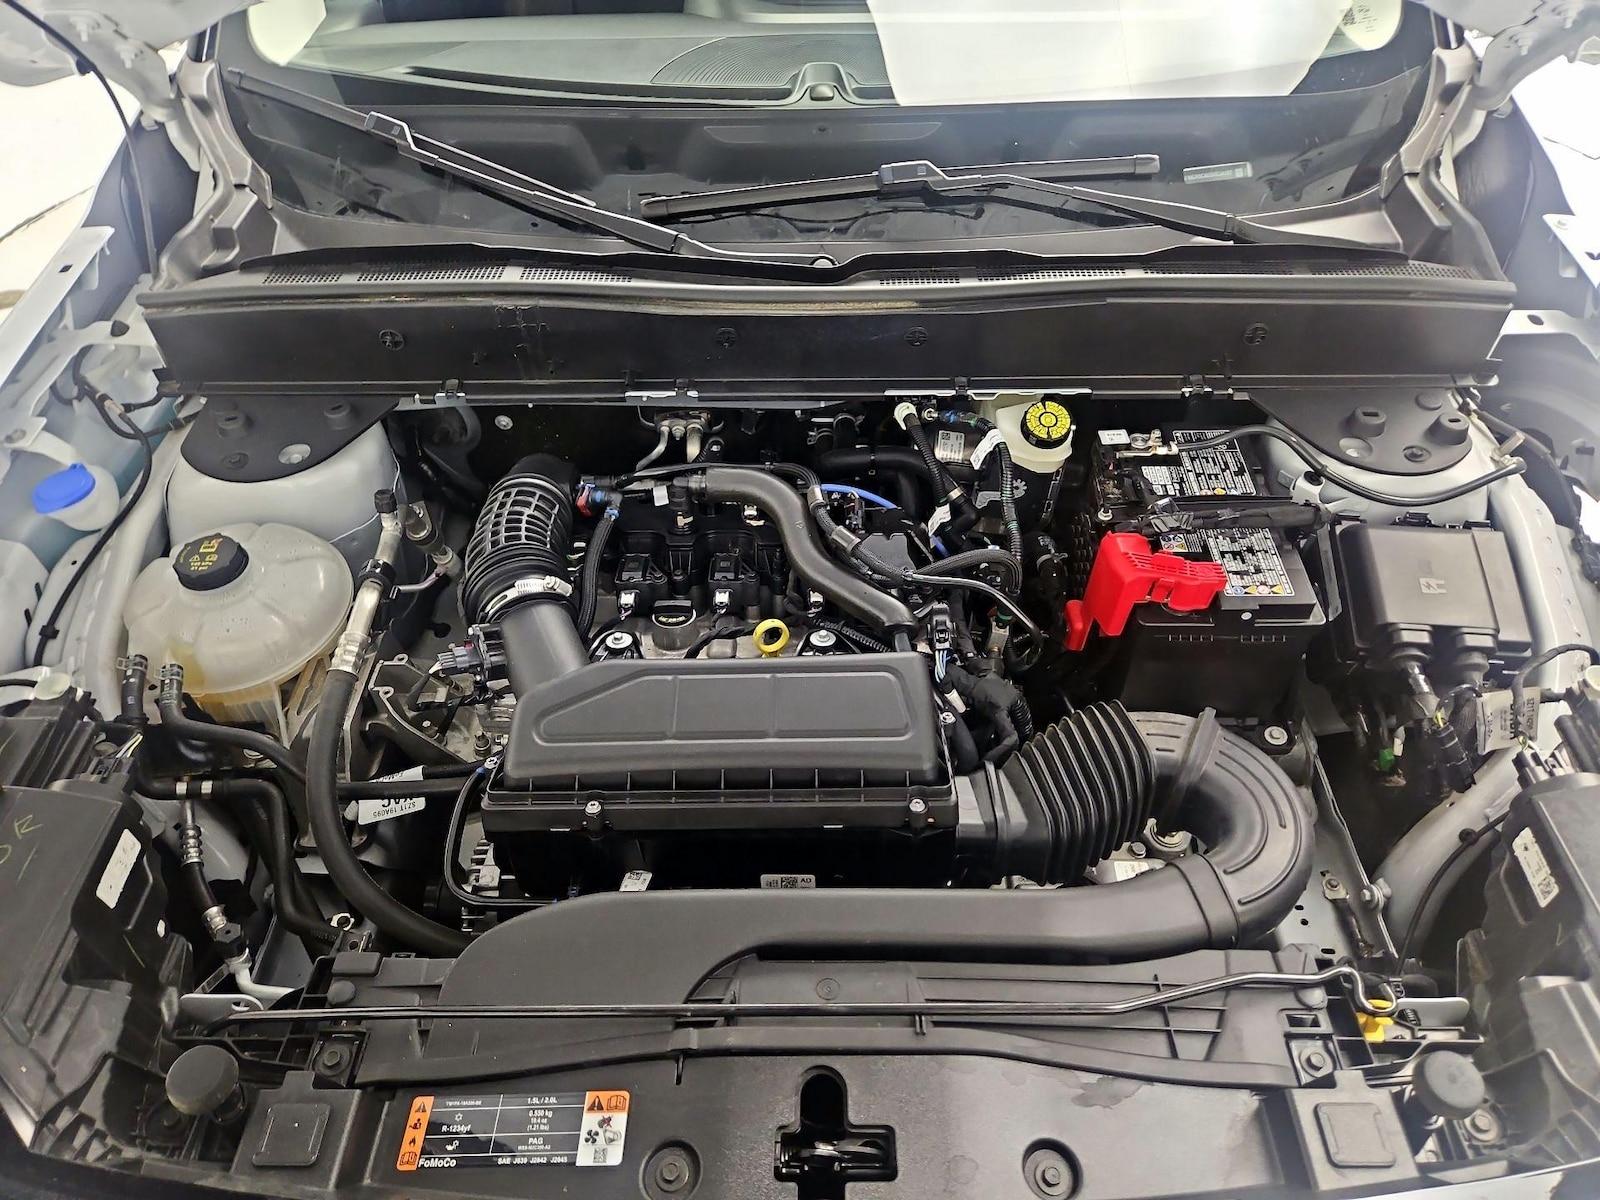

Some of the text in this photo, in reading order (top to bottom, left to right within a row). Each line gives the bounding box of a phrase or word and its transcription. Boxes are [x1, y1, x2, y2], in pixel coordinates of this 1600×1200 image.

[544, 1096, 558, 1104] 2.0L
[545, 1109, 553, 1118] kg
[441, 1124, 472, 1133] R-1234yf
[528, 1137, 544, 1145] PAG
[418, 1157, 457, 1168] FoMoCo
[497, 1157, 512, 1165] SAE
